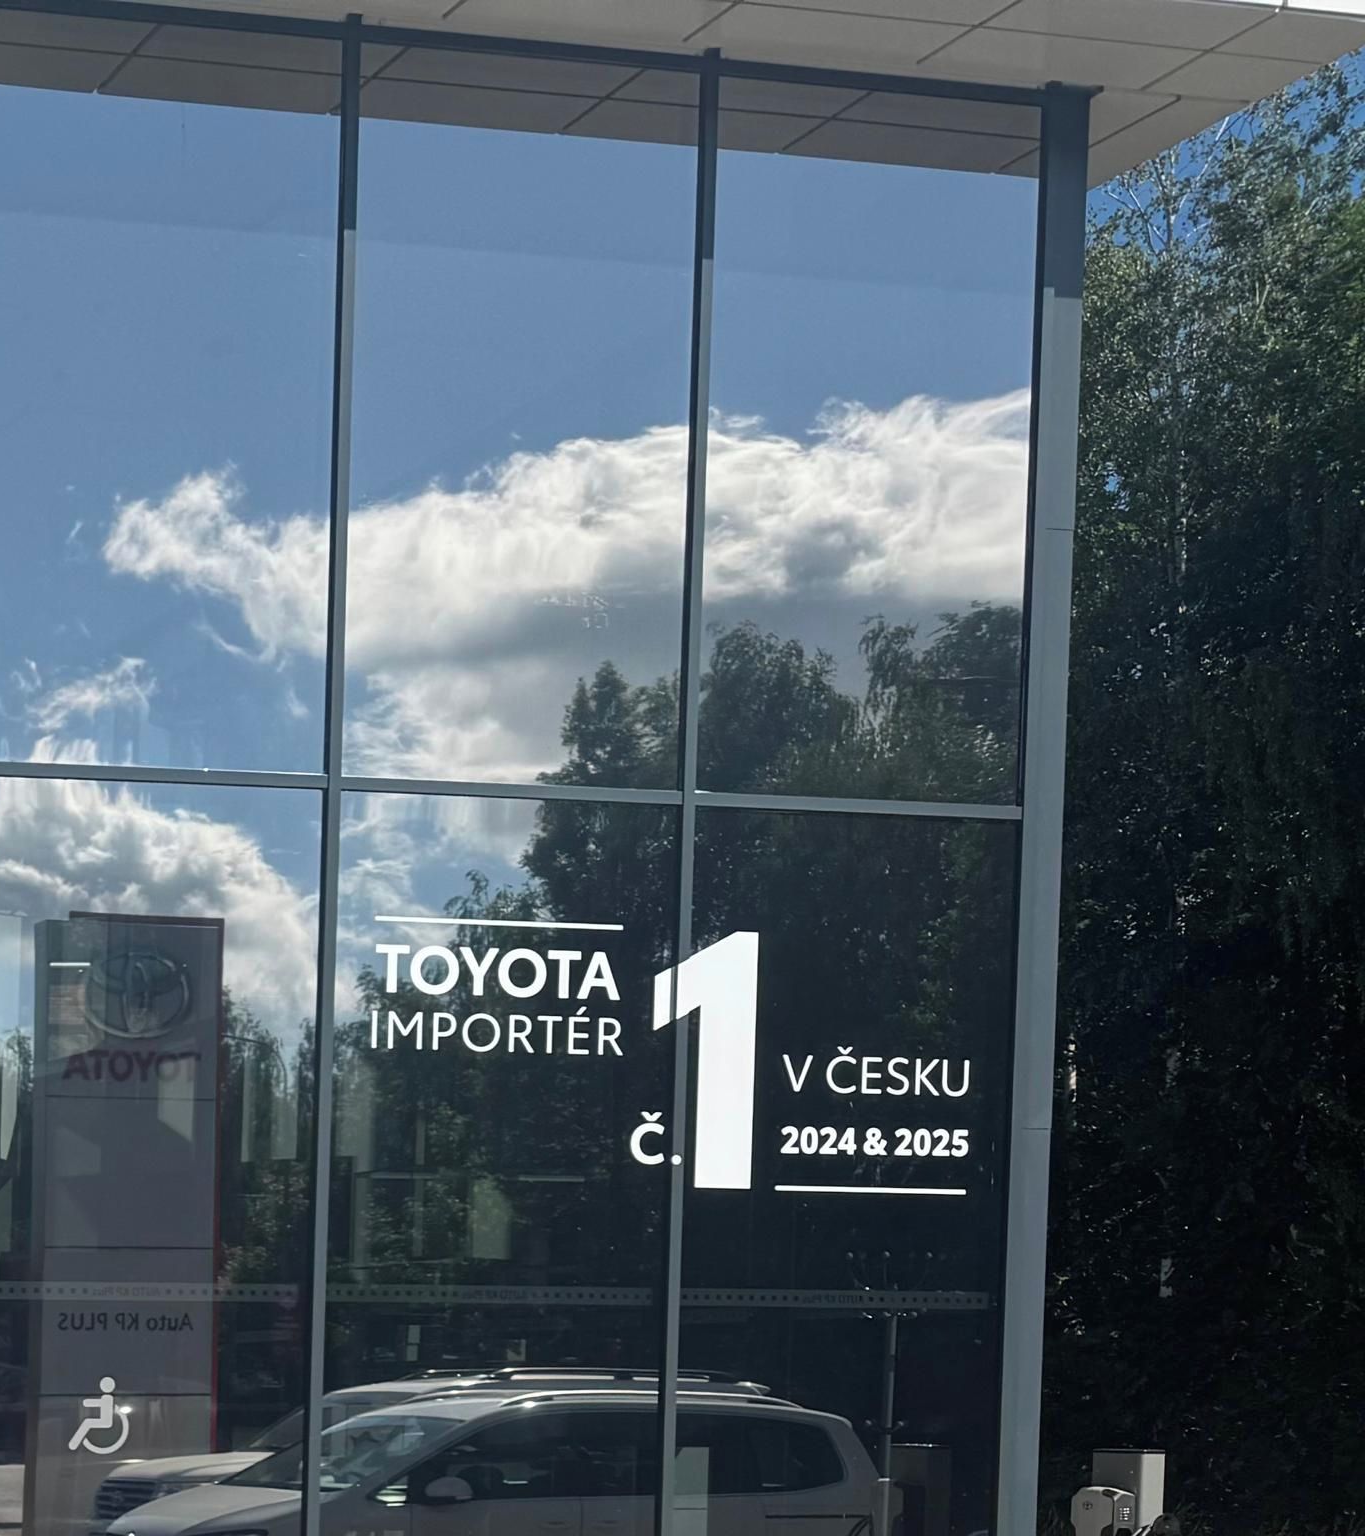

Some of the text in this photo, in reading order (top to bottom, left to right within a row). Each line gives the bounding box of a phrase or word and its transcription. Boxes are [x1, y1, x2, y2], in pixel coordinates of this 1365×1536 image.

[375, 943, 622, 1001] TOYOTA
[369, 1006, 623, 1056] IMPORTÉR
[653, 931, 759, 1190] 1
[782, 1046, 971, 1098] V ČESKU
[780, 1125, 969, 1158] 2024 & 2025
